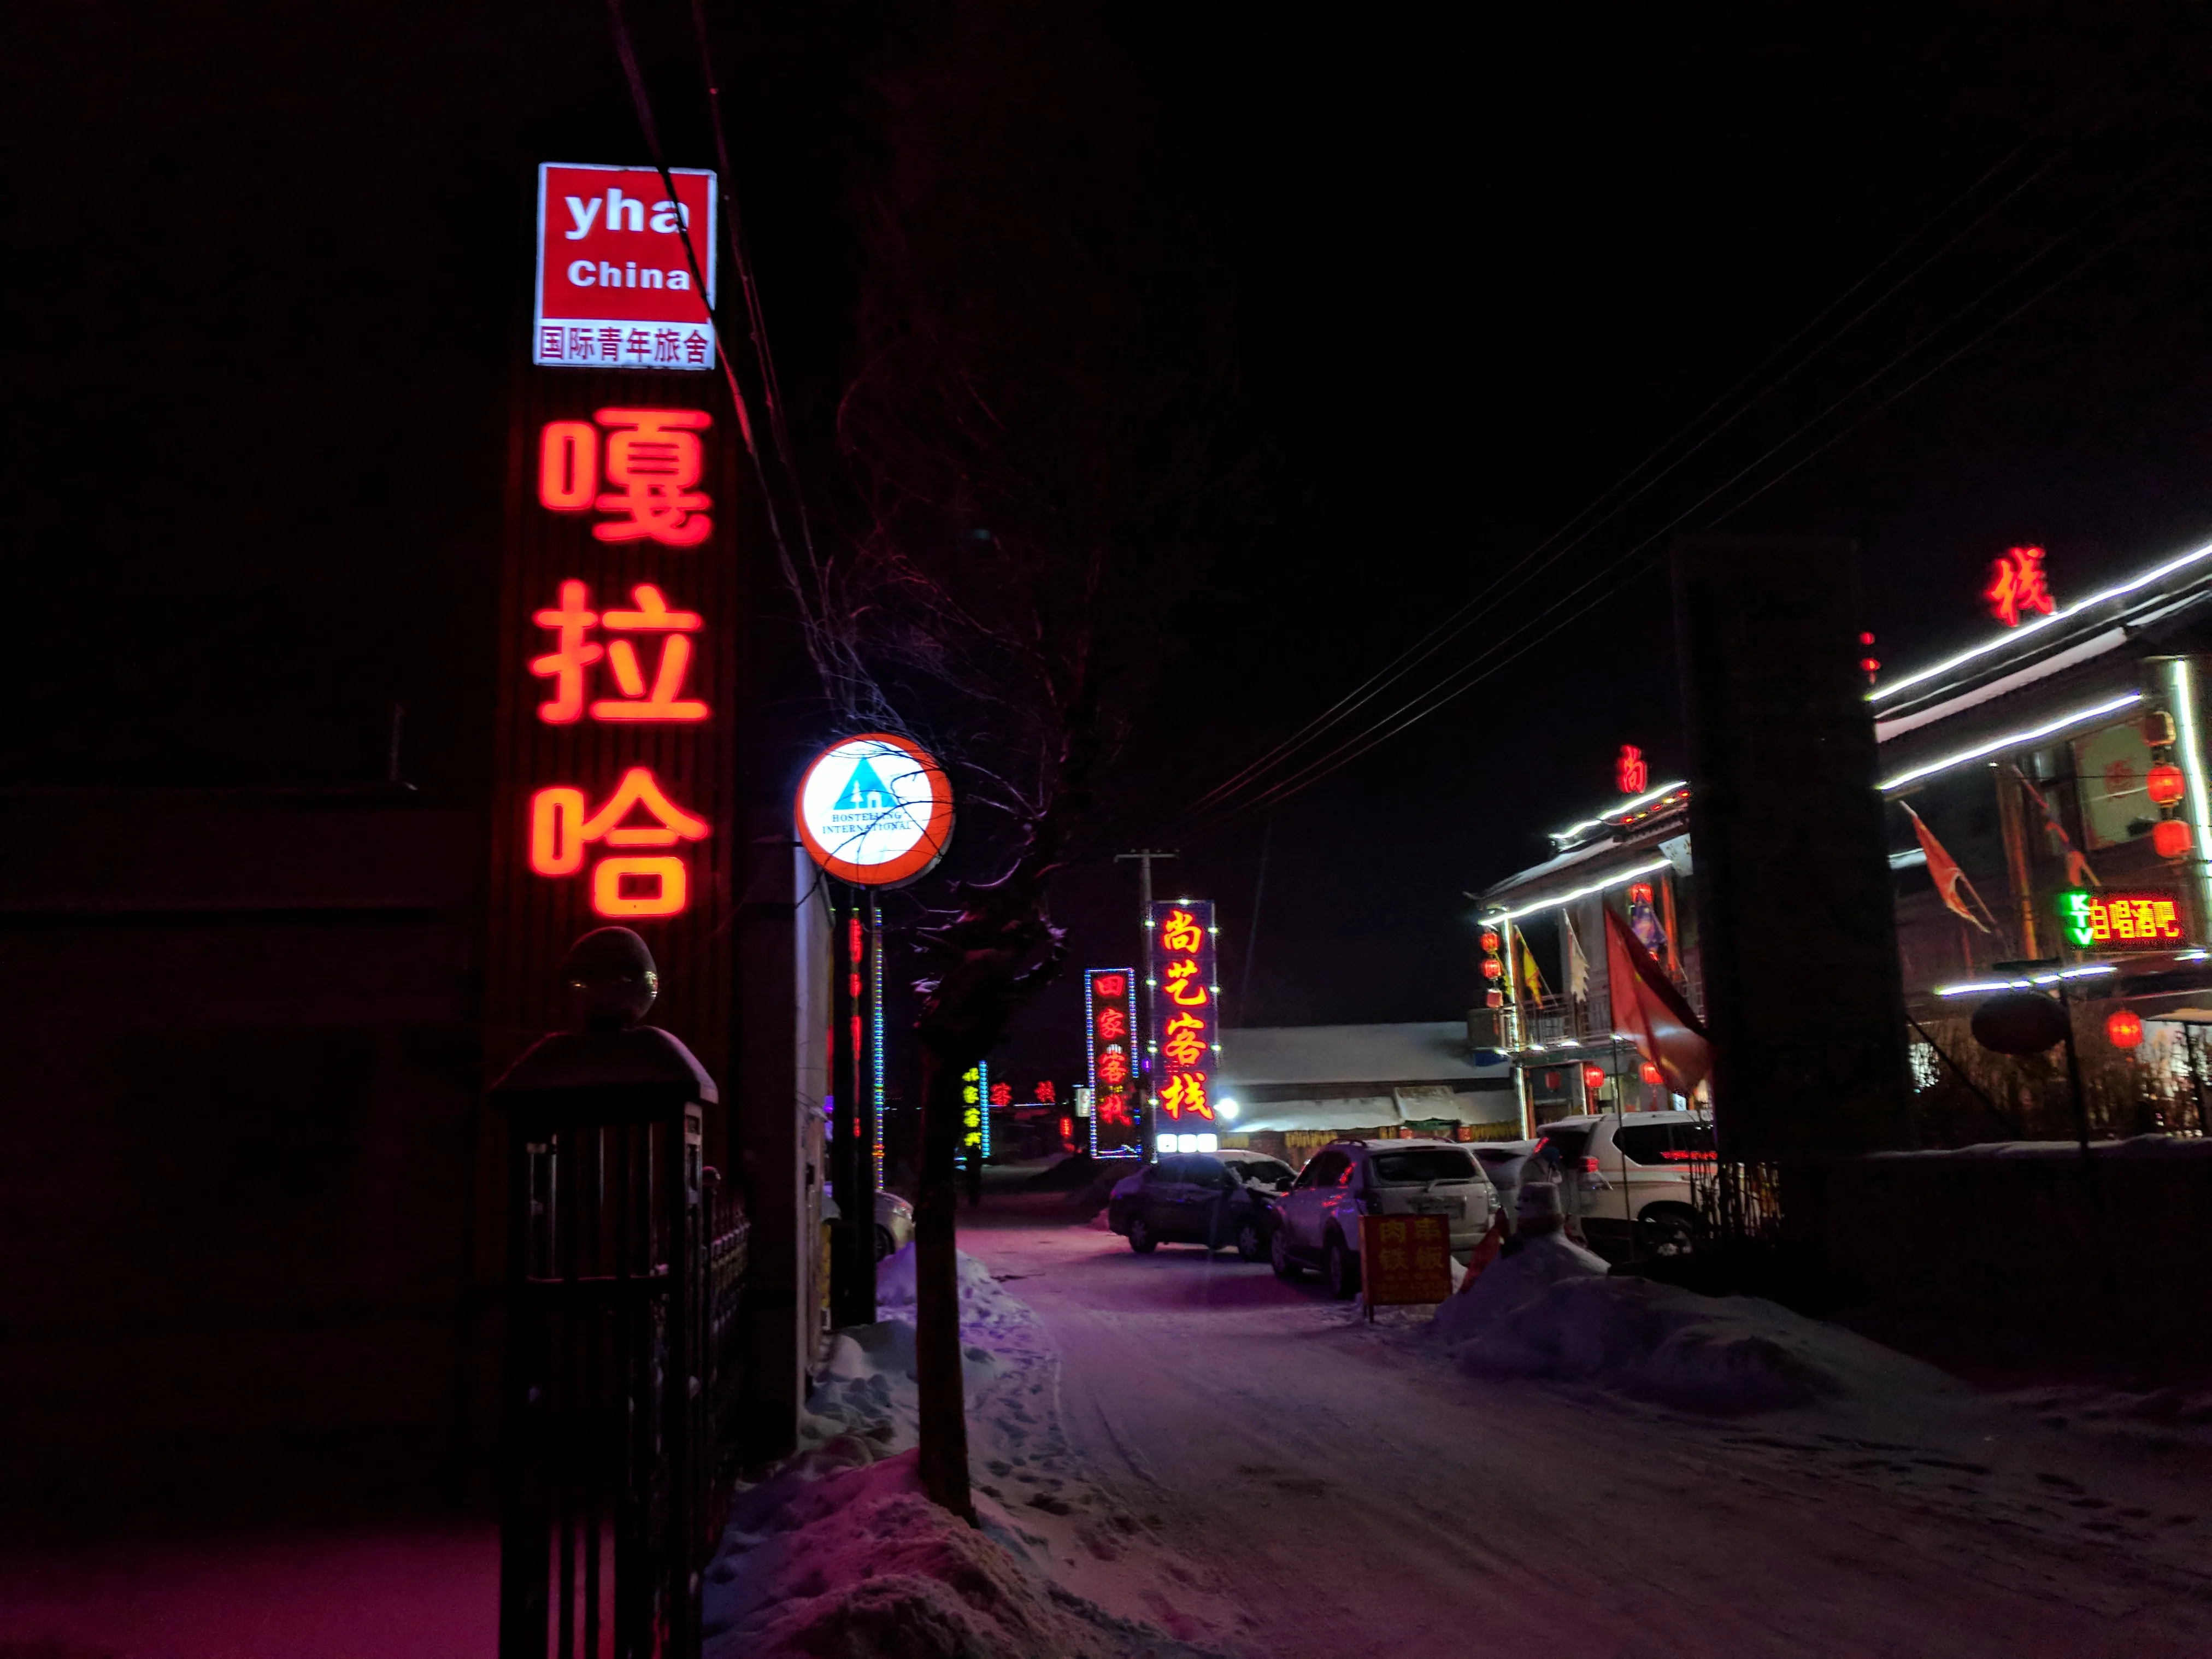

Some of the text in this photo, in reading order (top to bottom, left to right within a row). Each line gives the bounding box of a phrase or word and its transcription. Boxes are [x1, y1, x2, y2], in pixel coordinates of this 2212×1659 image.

[564, 187, 689, 240] yha
[568, 260, 690, 290] China
[540, 326, 709, 364] 国际青年旅舍
[530, 408, 713, 917] 嘎拉哈
[2068, 893, 2093, 945] KTV
[1161, 908, 1215, 1121] 尚艺客栈
